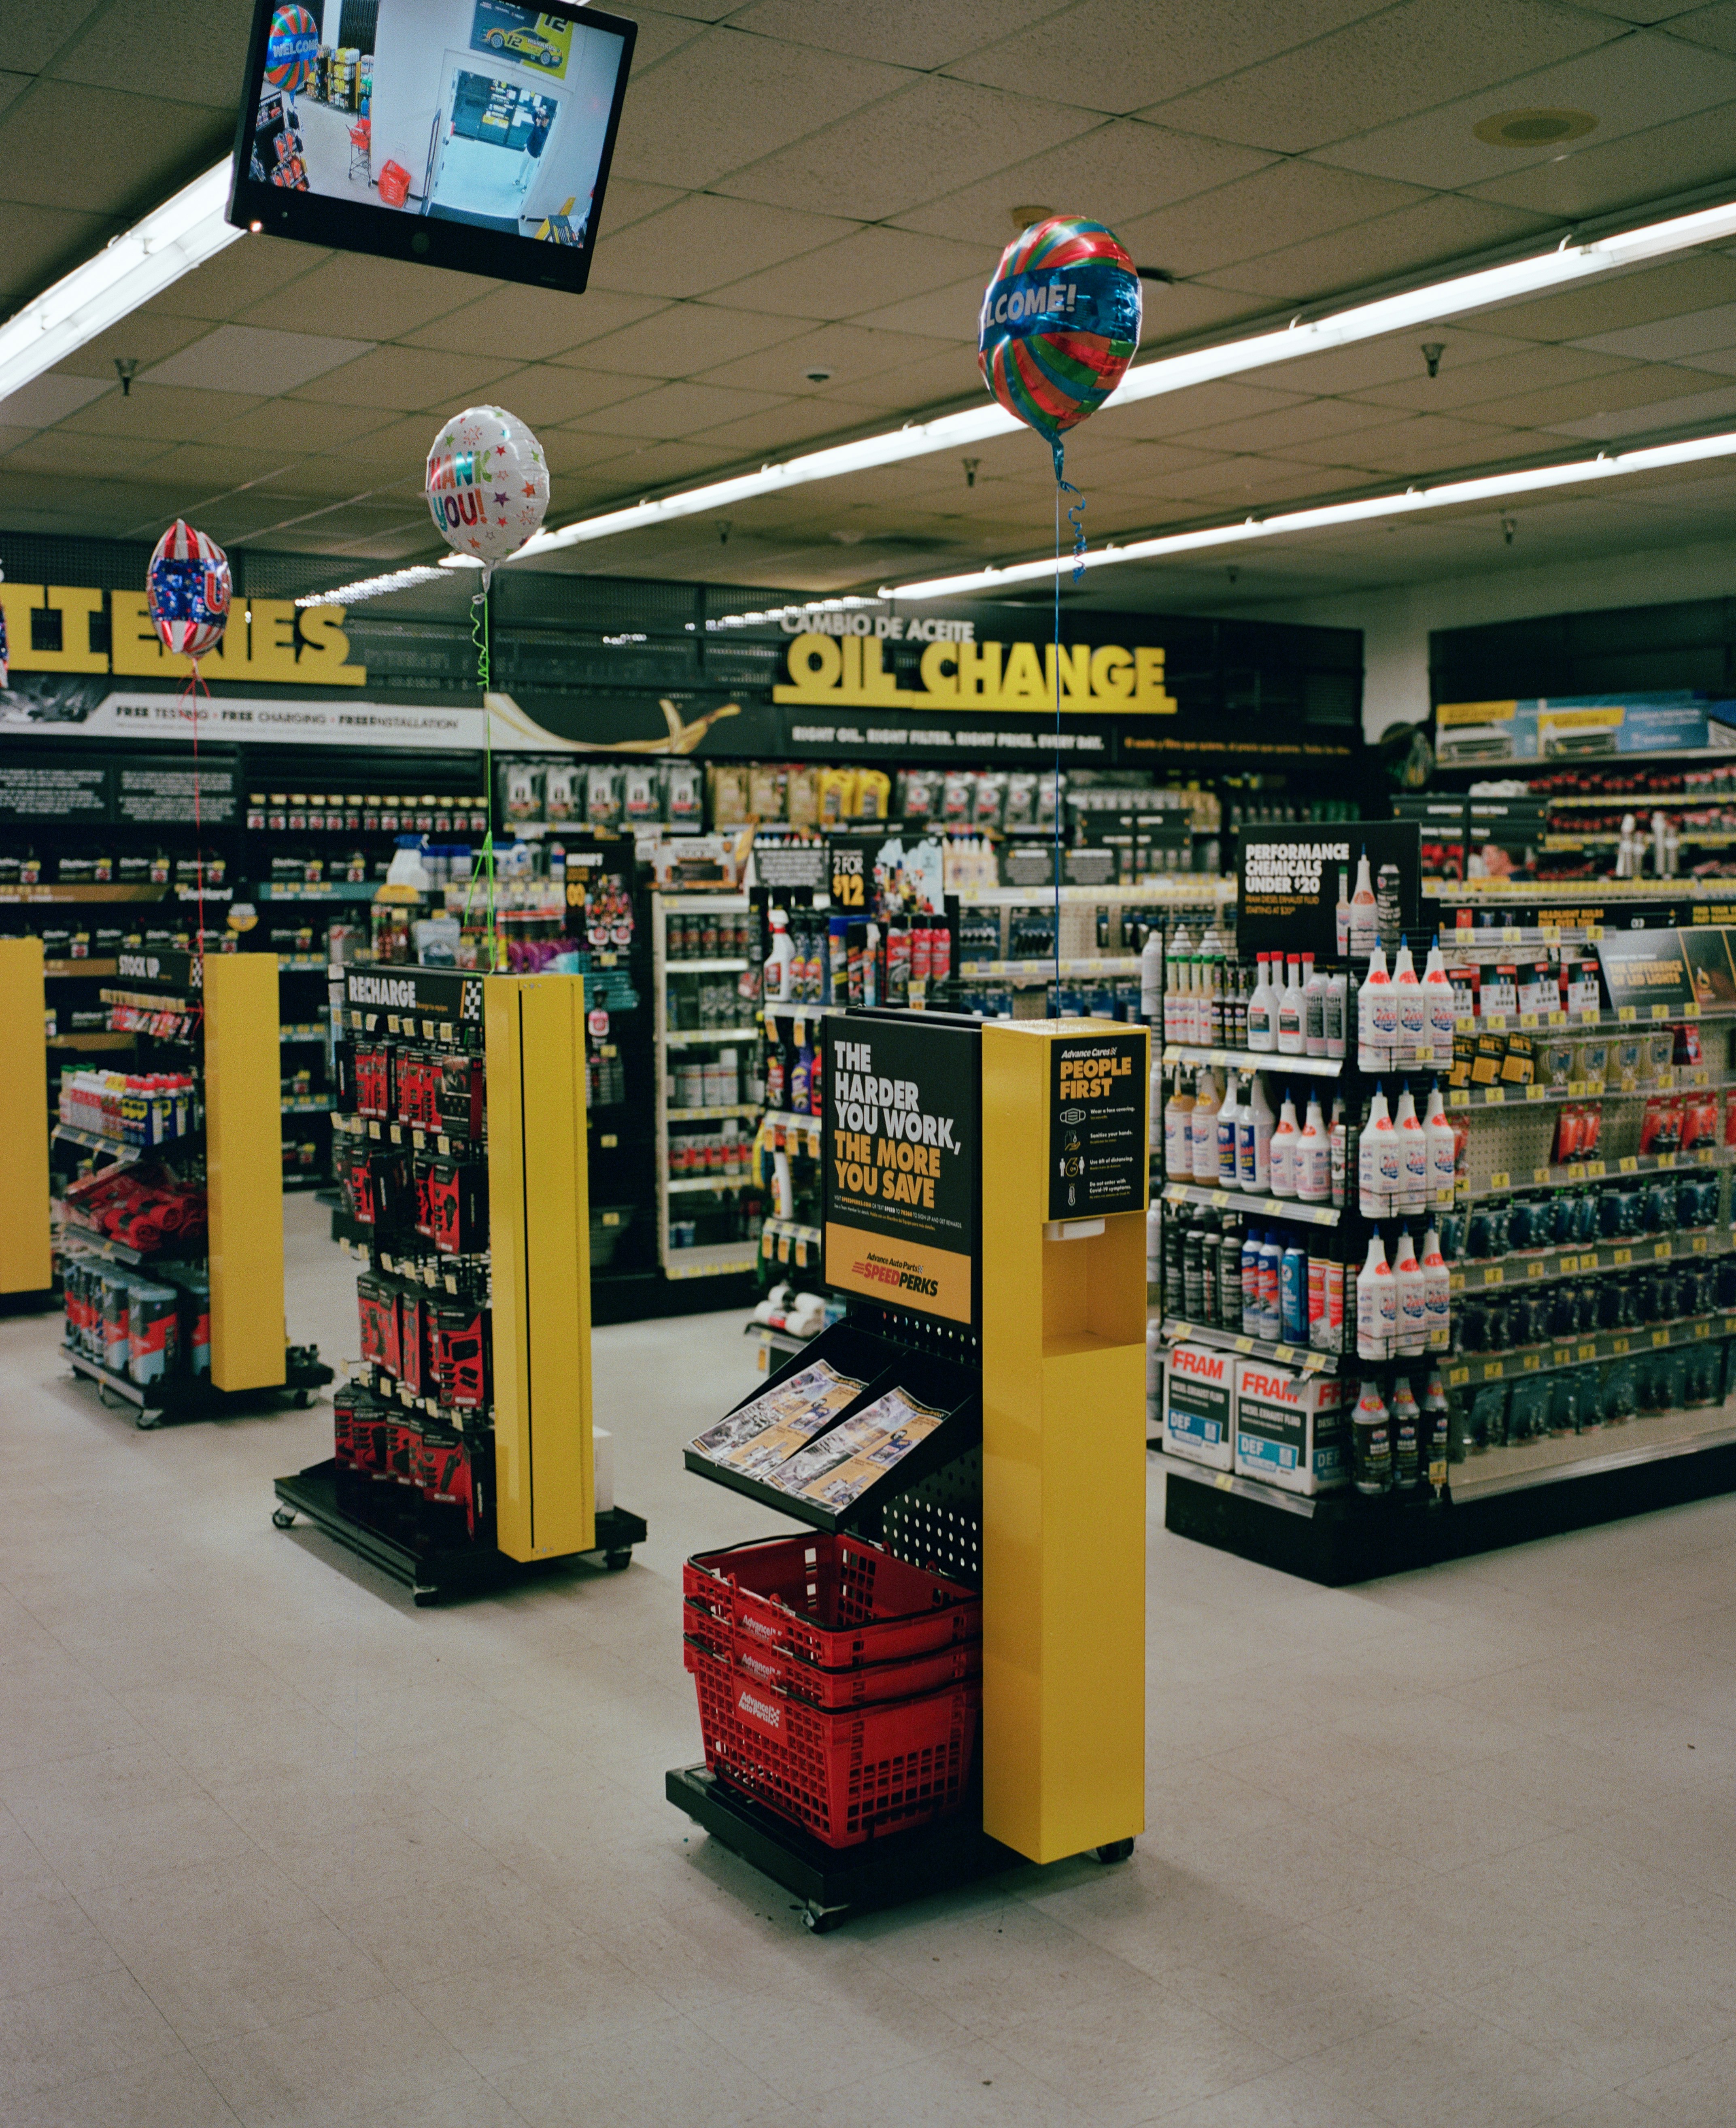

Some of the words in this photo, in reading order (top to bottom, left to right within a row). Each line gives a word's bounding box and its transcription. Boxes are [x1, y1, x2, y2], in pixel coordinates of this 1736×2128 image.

[984, 284, 1077, 328] LCOME!
[428, 449, 492, 492] HANK
[432, 488, 488, 532] YOU!
[780, 612, 872, 636] CAMBIO
[875, 616, 903, 640] DE
[906, 618, 975, 644] ACEITE
[786, 631, 897, 692] OIL
[919, 640, 1168, 702] CHANGE
[1245, 843, 1349, 860] PERFORMANCE
[842, 856, 864, 875] FOR
[1245, 860, 1323, 877] CHEMICALS
[832, 874, 865, 906] $12
[1245, 876, 1292, 893] UNDER
[1294, 876, 1321, 893] $20
[348, 976, 416, 1008] RECHARGE
[834, 1040, 871, 1072] THE
[1061, 1049, 1091, 1059] Advance
[1092, 1048, 1111, 1057] Cares
[1060, 1056, 1132, 1080] PEOPLE
[835, 1071, 920, 1113] HARDER
[1060, 1077, 1113, 1100] FIRST
[834, 1100, 878, 1135] YOU
[883, 1108, 961, 1156] WORK,
[834, 1129, 871, 1164] THE
[877, 1137, 941, 1178] MORE
[834, 1160, 878, 1196] YOU
[882, 1170, 935, 1209] SAVE
[884, 1205, 896, 1214] SPEED
[867, 1252, 889, 1265] Advance
[889, 1258, 903, 1268] Auto
[903, 1261, 918, 1272] Parts
[863, 1262, 939, 1297] SPEEDPERKS
[1173, 1349, 1224, 1380] FRAM
[1170, 1412, 1191, 1429] DEF
[1241, 1437, 1264, 1456] DEF
[742, 1614, 770, 1636] Advance
[738, 1700, 753, 1714] Auto
[740, 1691, 769, 1714] Advance
[753, 1706, 770, 1723] Parts
